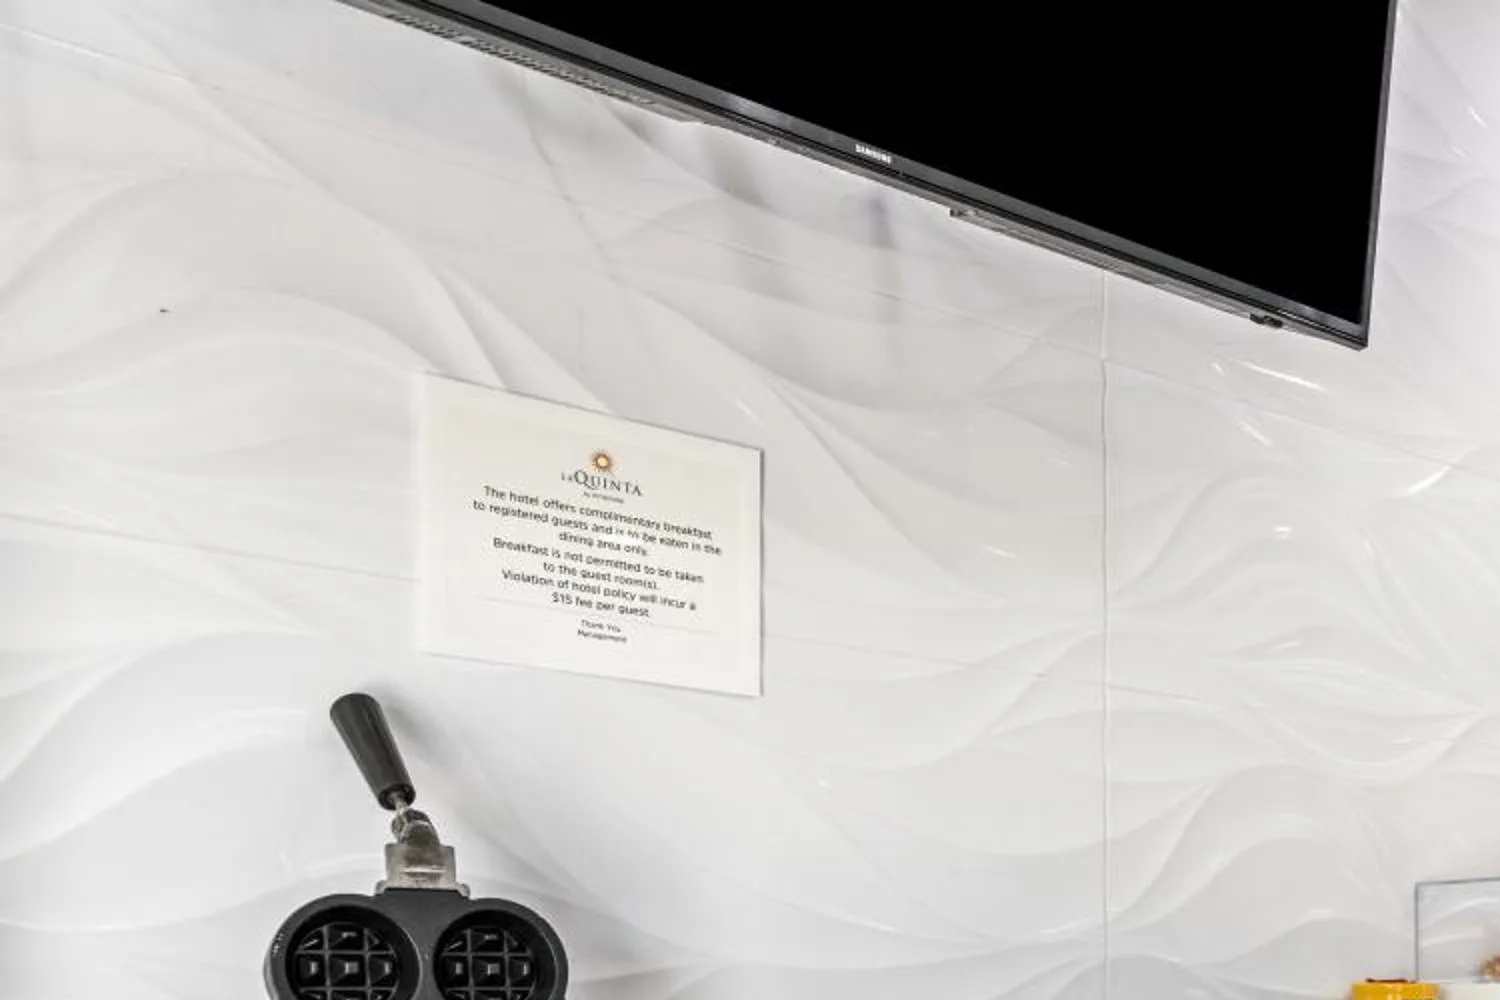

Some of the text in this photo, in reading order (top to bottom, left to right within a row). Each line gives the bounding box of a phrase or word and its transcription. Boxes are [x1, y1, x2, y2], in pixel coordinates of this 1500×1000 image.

[574, 469, 643, 497] QUINTA
[473, 500, 486, 511] to
[489, 503, 549, 524] registered
[552, 514, 588, 533] guests
[592, 520, 613, 536] and
[642, 531, 657, 545] be
[659, 536, 689, 551] eaten
[704, 542, 722, 557] the
[483, 485, 712, 539] The hotel offers complimentary breakfast
[493, 537, 549, 557] Breakfast
[552, 547, 561, 559] is
[564, 550, 583, 563] not
[586, 554, 641, 574] permitted
[644, 564, 656, 575] to
[658, 565, 673, 577] be
[559, 532, 594, 548] dining
[597, 538, 621, 551] area
[501, 569, 554, 587] Violation
[557, 578, 570, 590] of
[571, 580, 601, 596] hotel
[603, 586, 637, 603] policy
[639, 592, 658, 605] will
[660, 595, 687, 609] incur
[543, 561, 555, 573] to
[558, 564, 577, 577] the
[580, 569, 612, 584] guest
[552, 591, 573, 606] $15
[575, 595, 594, 609] fee
[596, 599, 616, 613] per
